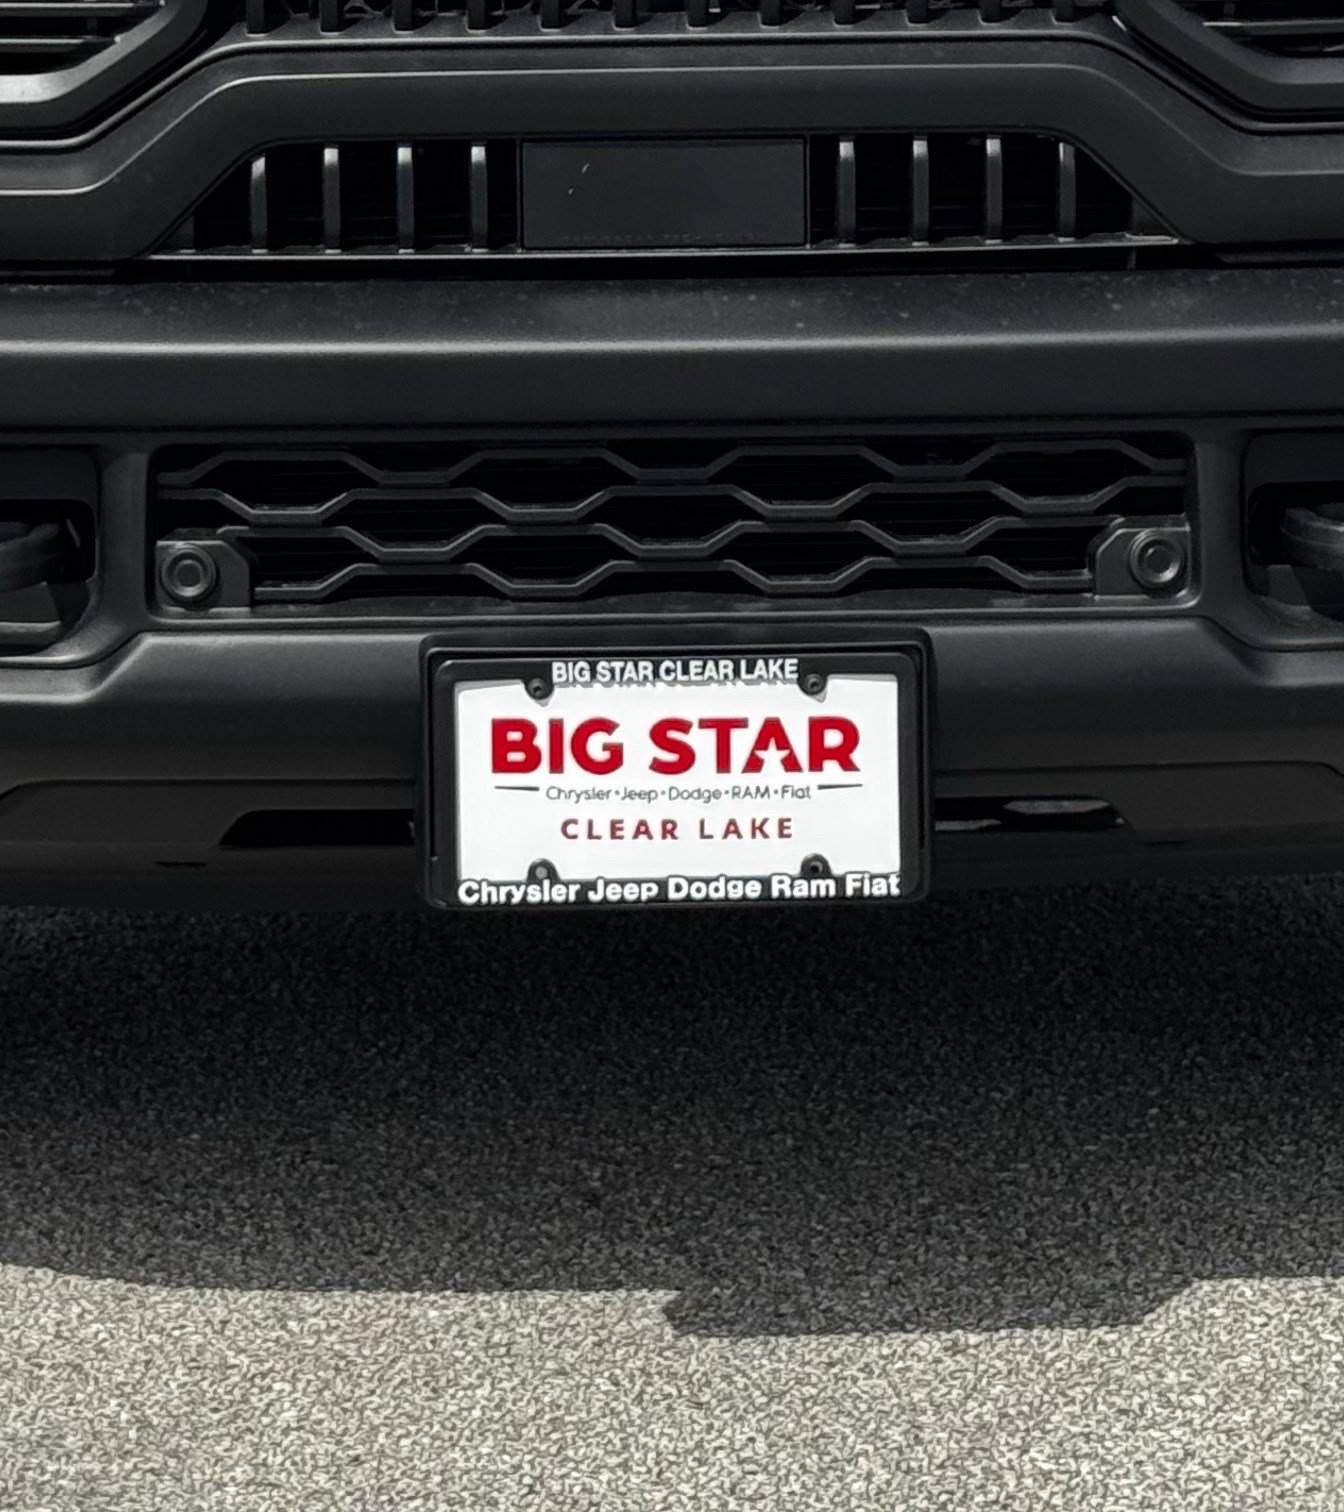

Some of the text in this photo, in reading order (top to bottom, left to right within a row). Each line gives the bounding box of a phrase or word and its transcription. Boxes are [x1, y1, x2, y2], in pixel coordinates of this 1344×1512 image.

[551, 658, 799, 683] BIG STAR CLEAR LAKE
[490, 715, 861, 775] BIG STAR
[545, 784, 811, 804] Chrysler Jeep Dodge RAM Fiat
[560, 817, 793, 840] CLEAR LAKE
[457, 872, 901, 906] Chrysler Jeep Dodge Ram Fiat
